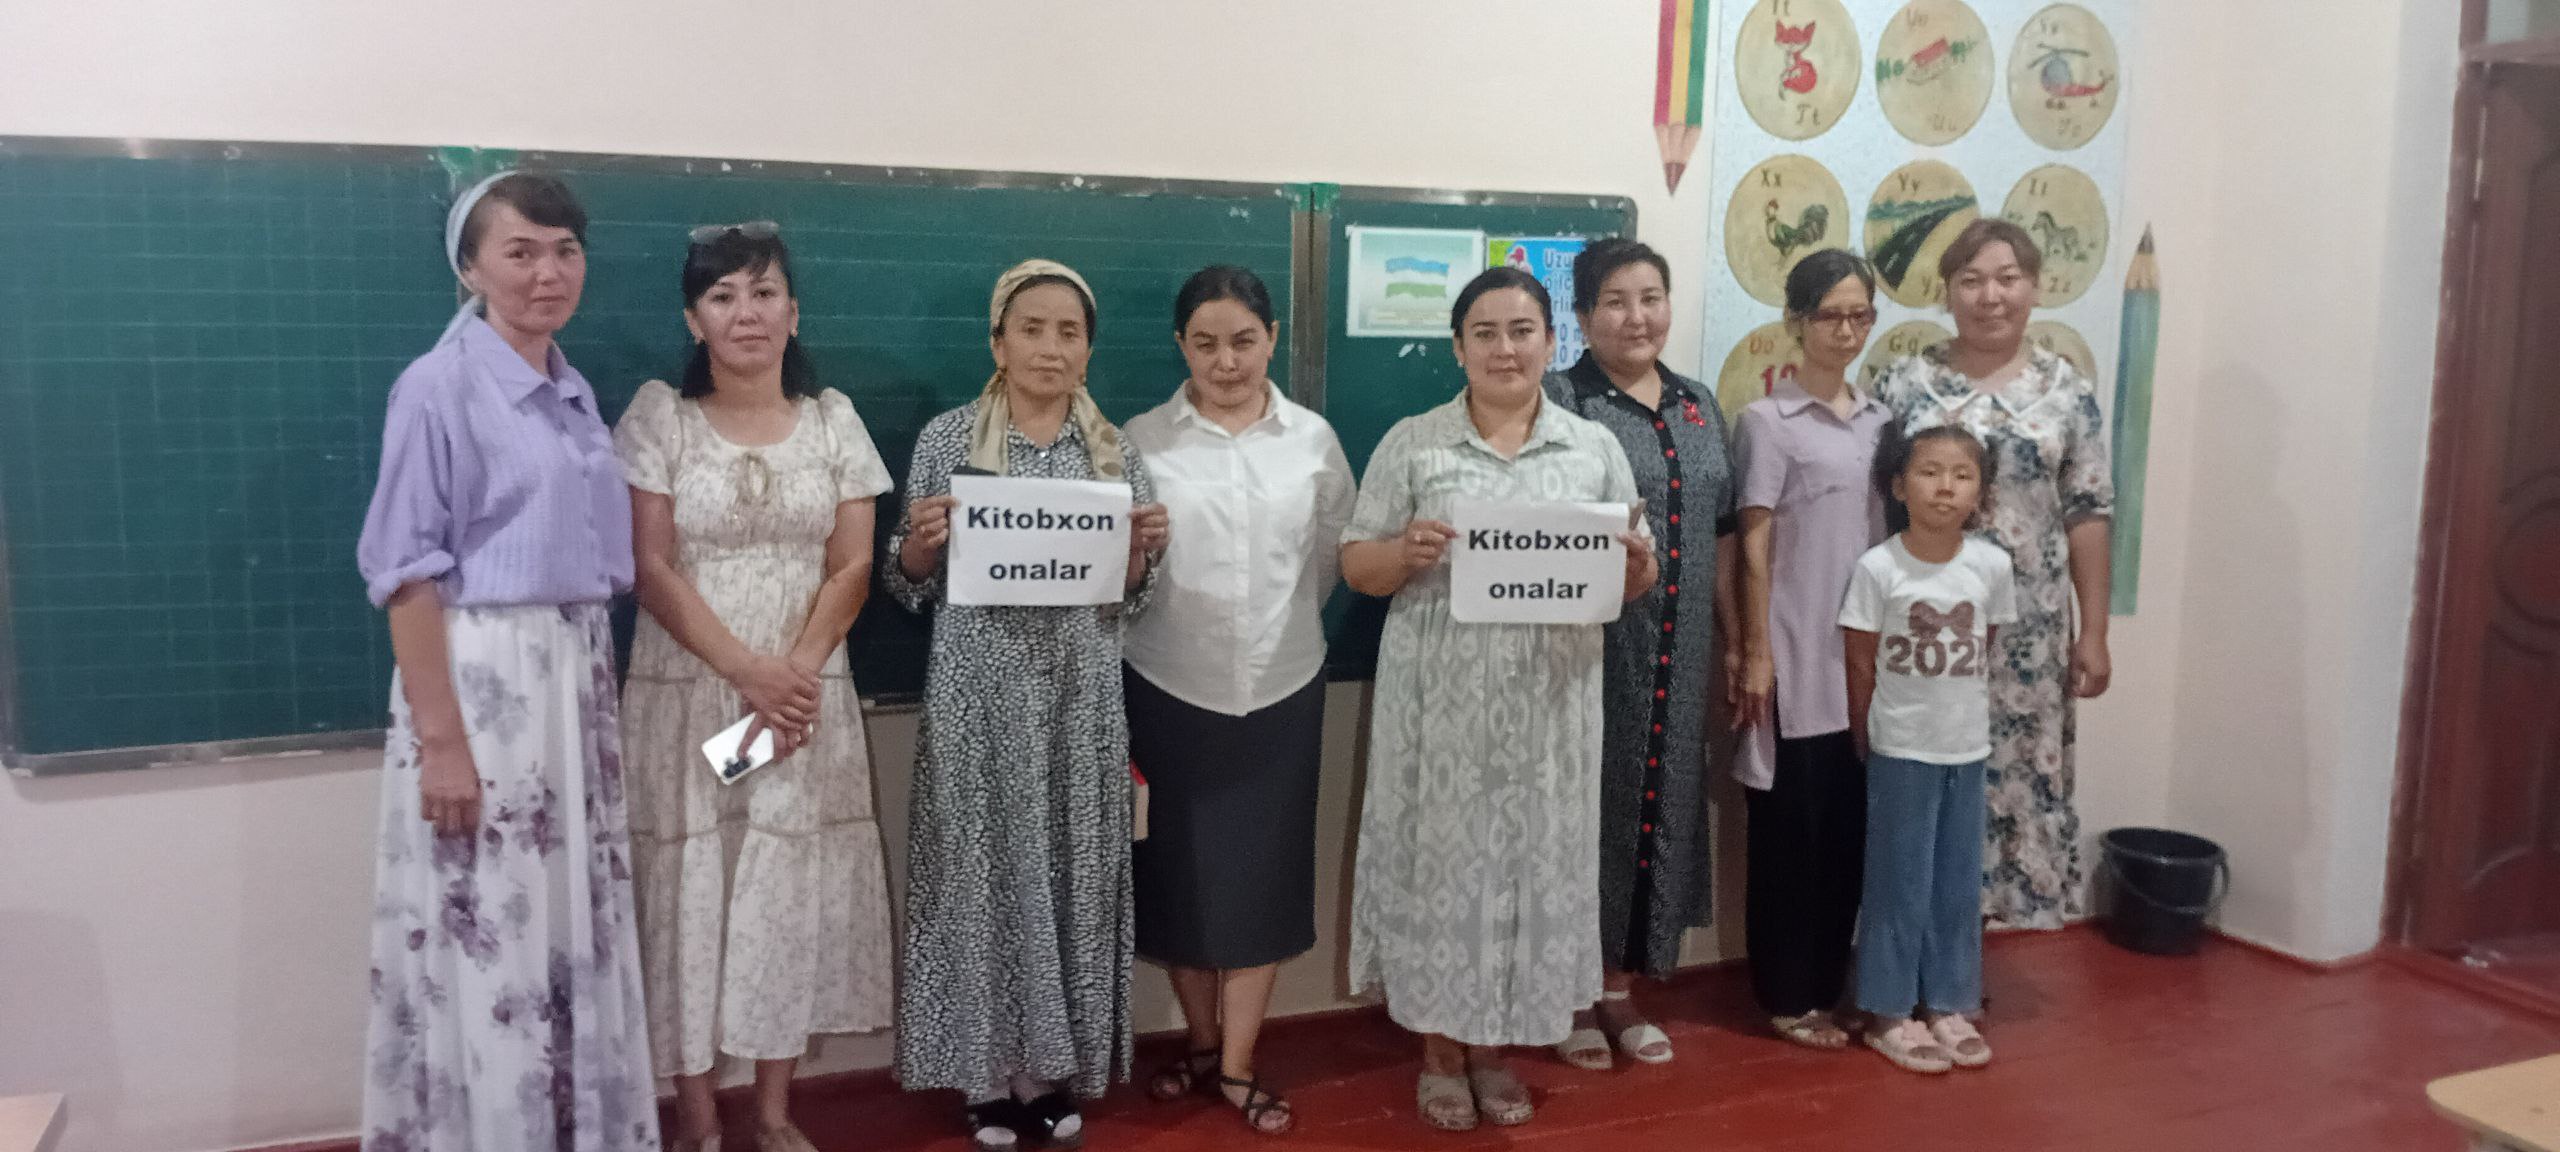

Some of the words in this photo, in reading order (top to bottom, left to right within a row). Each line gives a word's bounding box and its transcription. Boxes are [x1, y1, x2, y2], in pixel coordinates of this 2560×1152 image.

[1544, 248, 1573, 269] Uzu
[967, 506, 1114, 531] Kitobxon
[1469, 529, 1610, 551] Kitobxon
[989, 558, 1092, 580] onalar
[1489, 577, 1588, 599] onalar
